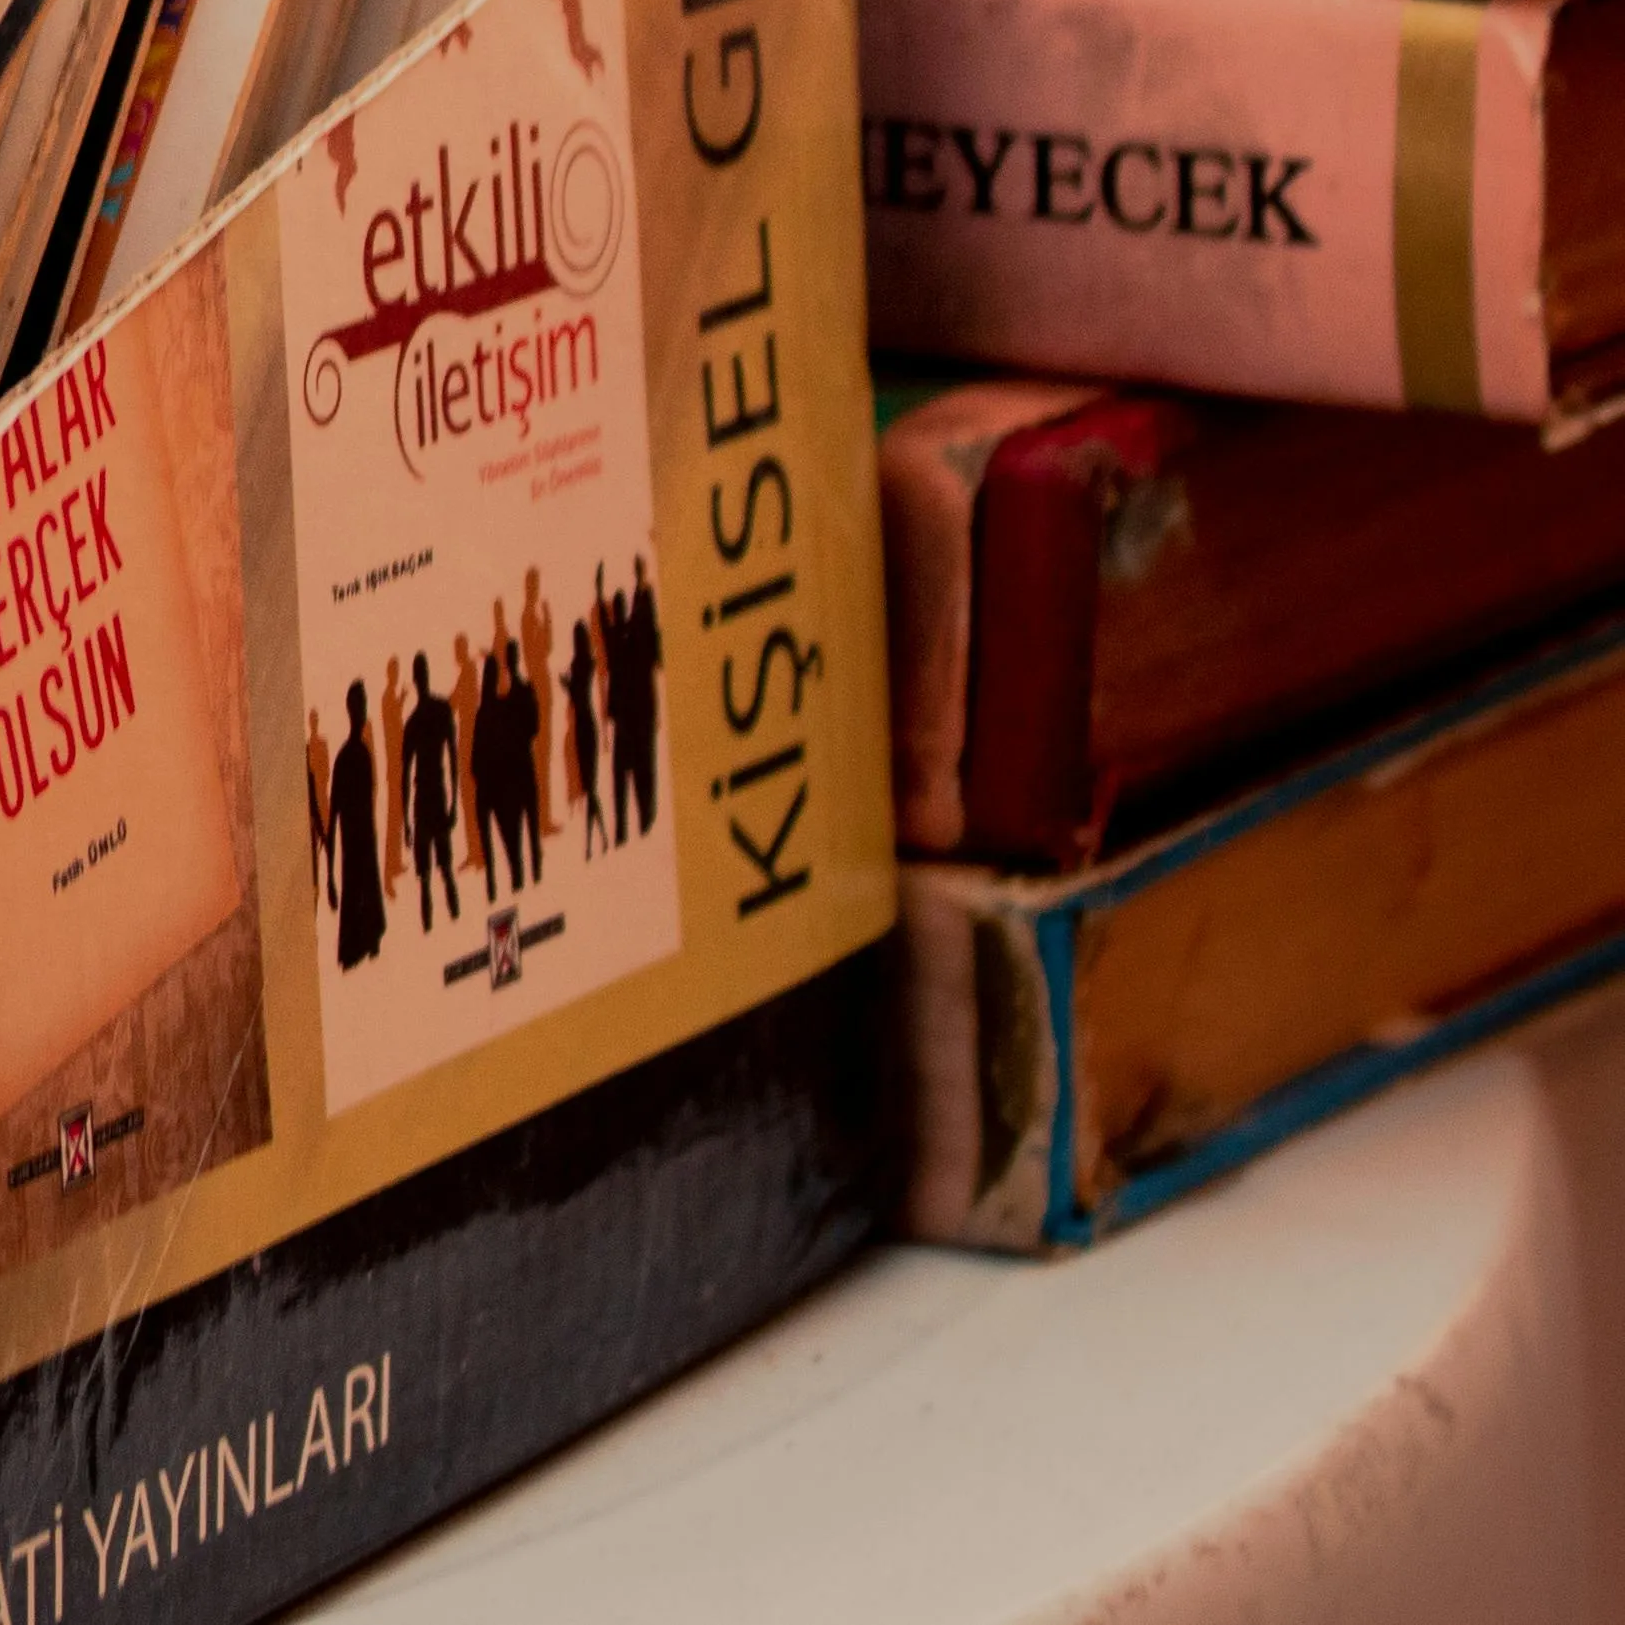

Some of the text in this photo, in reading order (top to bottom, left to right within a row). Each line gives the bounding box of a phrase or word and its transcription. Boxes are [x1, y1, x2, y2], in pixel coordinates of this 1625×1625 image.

[362, 119, 547, 314] etkili
[862, 113, 1320, 248] EYECEK
[413, 307, 599, 450] iletişim
[698, 215, 825, 922] KİŞİSEL
[82, 1350, 392, 1600] YAYINLARI
